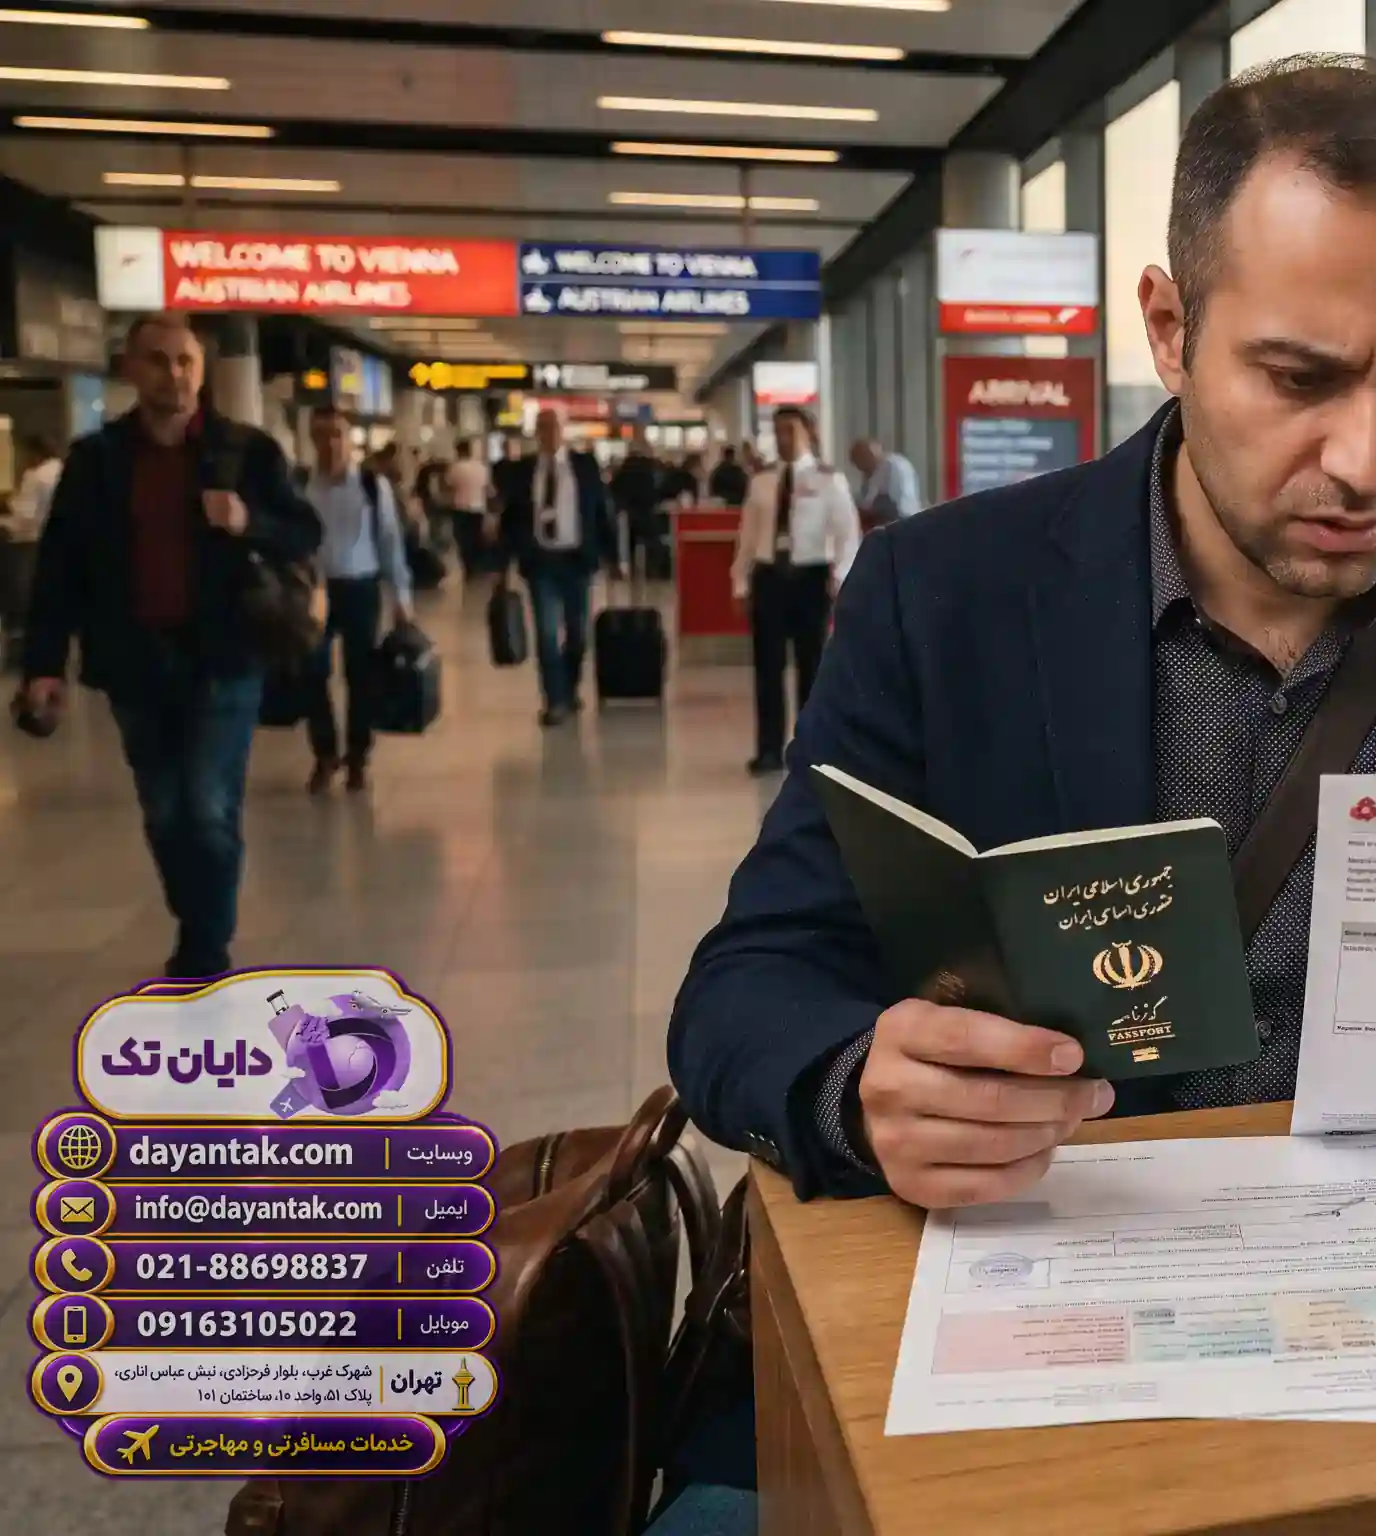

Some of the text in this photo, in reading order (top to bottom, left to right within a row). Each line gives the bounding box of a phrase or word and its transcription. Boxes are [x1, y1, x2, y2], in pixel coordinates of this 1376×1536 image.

[169, 241, 460, 277] WELCOME TO VIENNA
[554, 250, 652, 275] WELCOME
[655, 252, 684, 277] TO
[1043, 885, 1081, 906] ایران
